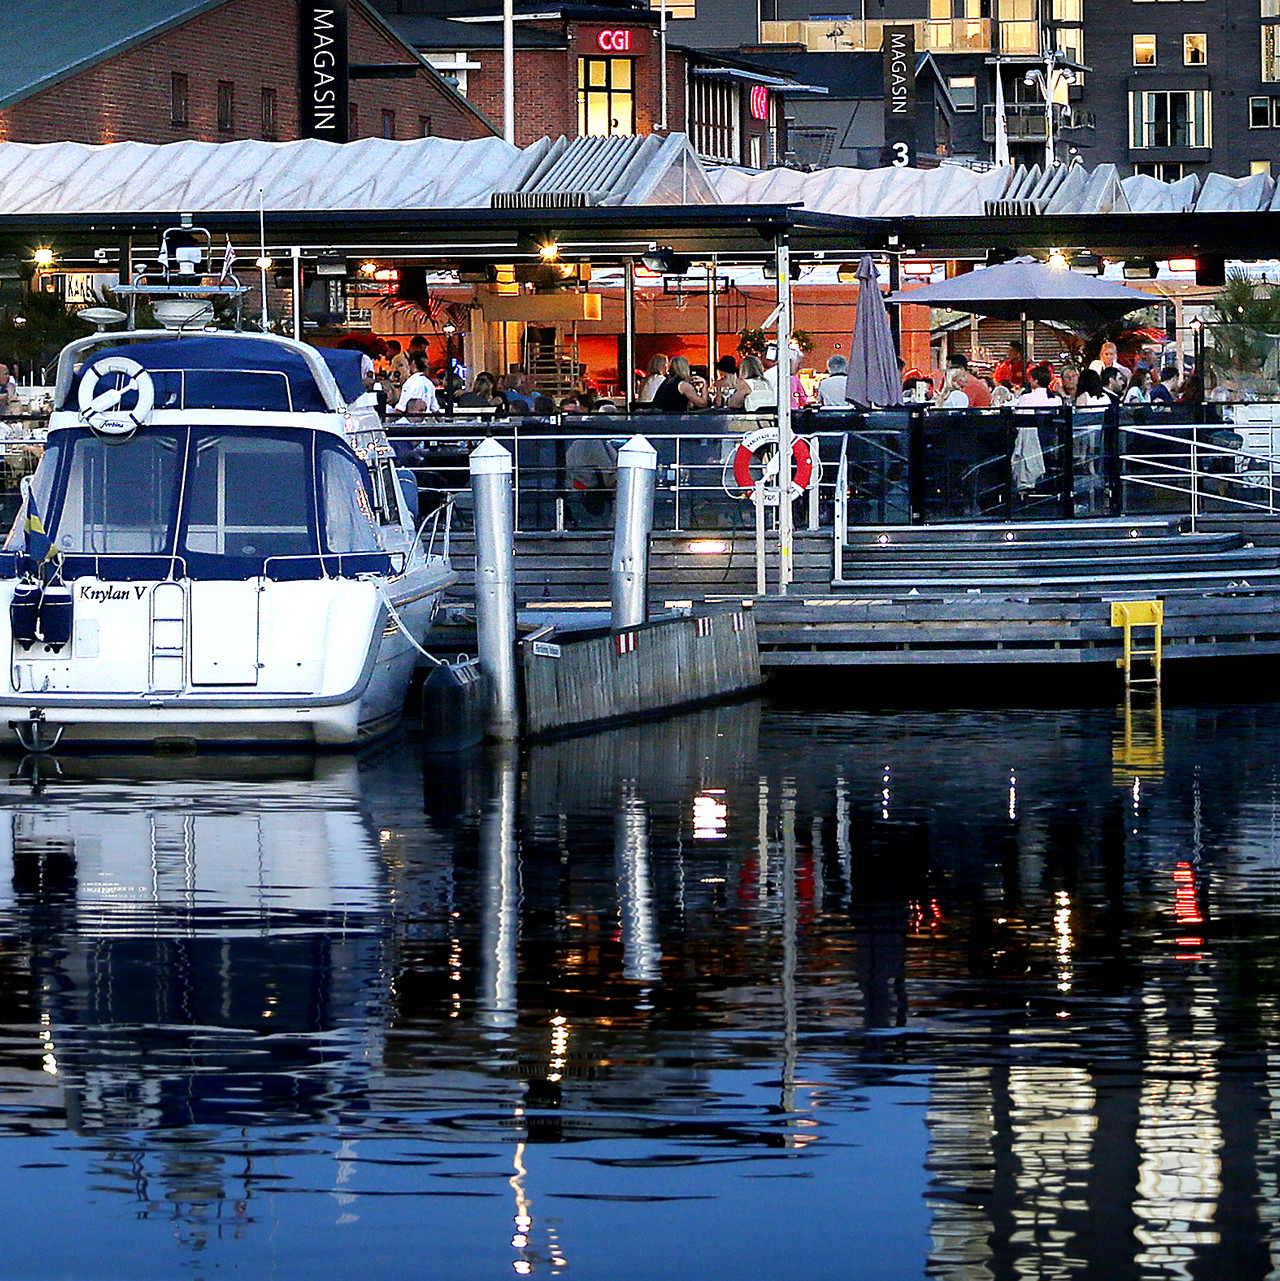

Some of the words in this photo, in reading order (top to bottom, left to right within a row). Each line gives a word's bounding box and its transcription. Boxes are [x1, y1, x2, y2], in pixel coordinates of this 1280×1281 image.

[598, 29, 632, 51] CGI
[313, 8, 336, 130] MAGASIN
[891, 33, 908, 114] MAGASIN
[892, 142, 910, 168] 3
[80, 585, 130, 604] Knylan
[134, 586, 148, 600] V
